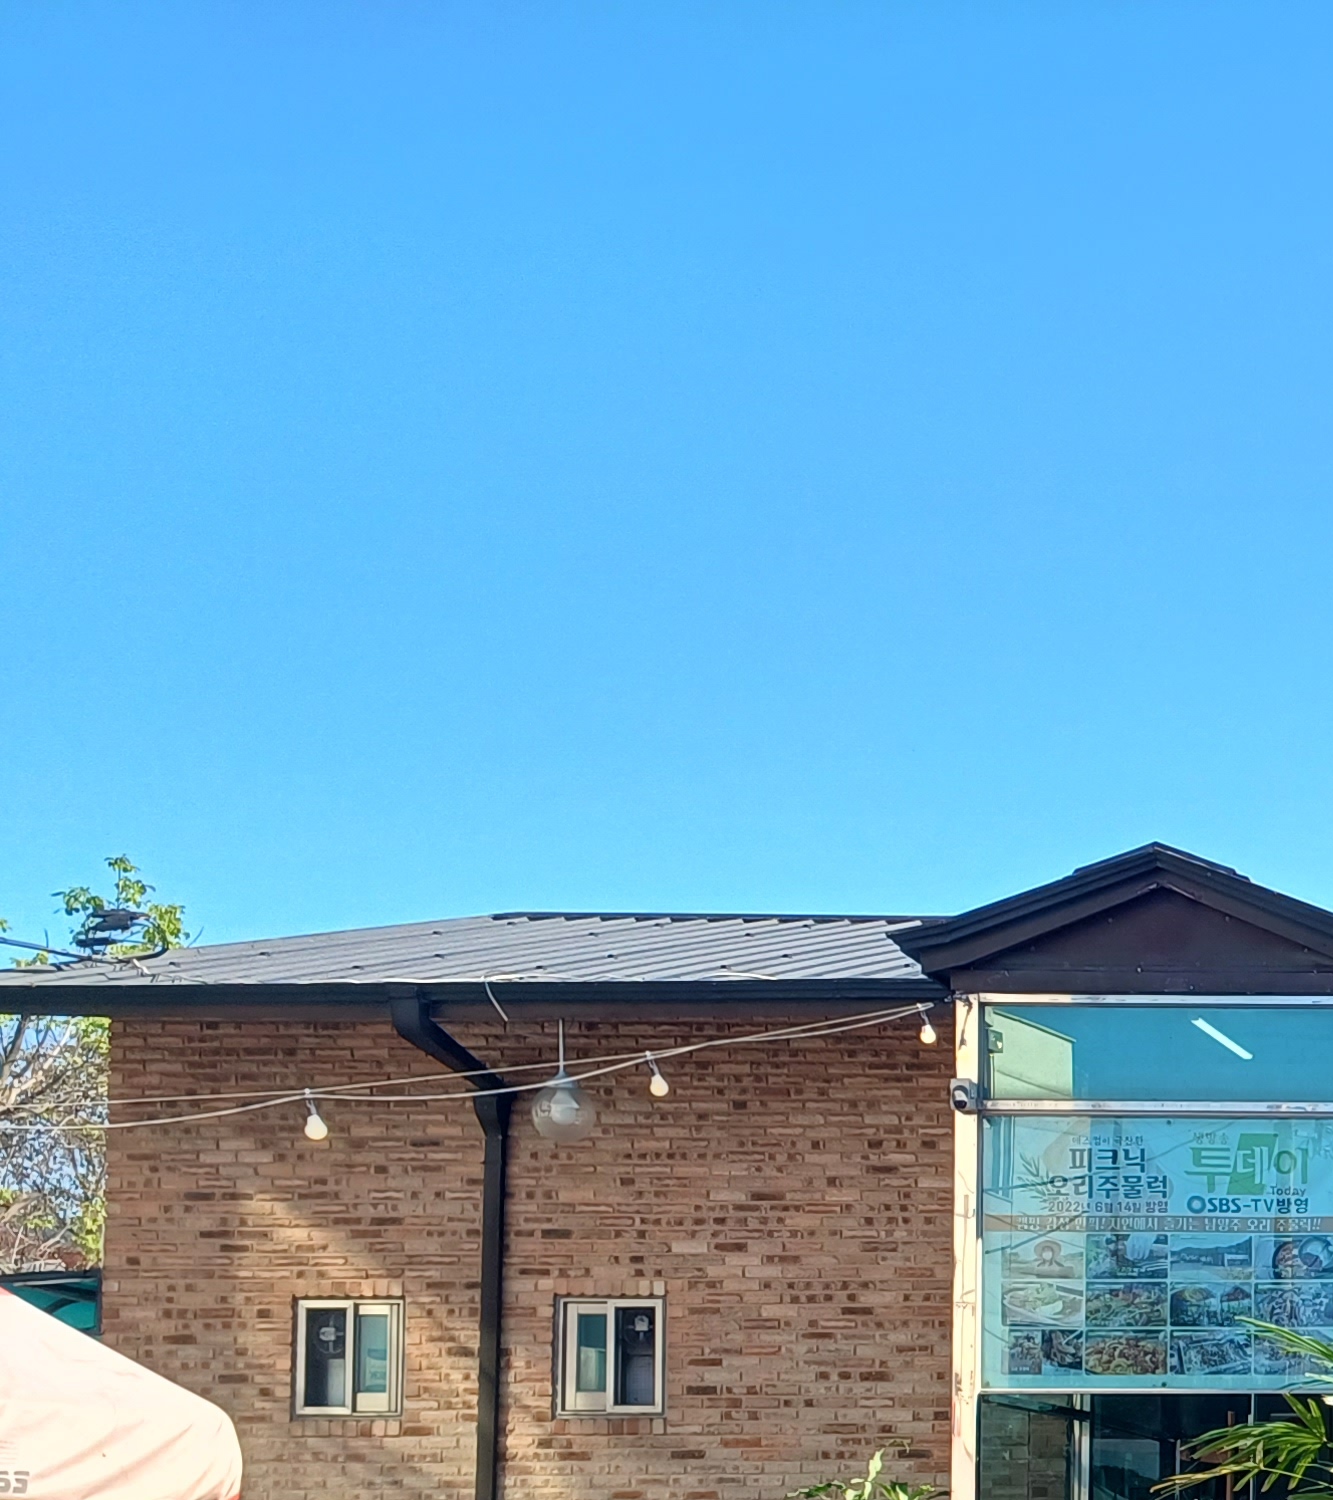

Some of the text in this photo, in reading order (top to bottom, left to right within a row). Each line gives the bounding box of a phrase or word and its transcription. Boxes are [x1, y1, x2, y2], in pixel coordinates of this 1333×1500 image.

[1068, 1147, 1146, 1173] 피크닉
[1184, 1146, 1308, 1194] 투데이
[1047, 1174, 1168, 1200] 오리주물럭
[1270, 1185, 1307, 1197] Today
[1145, 1201, 1169, 1213] 방영
